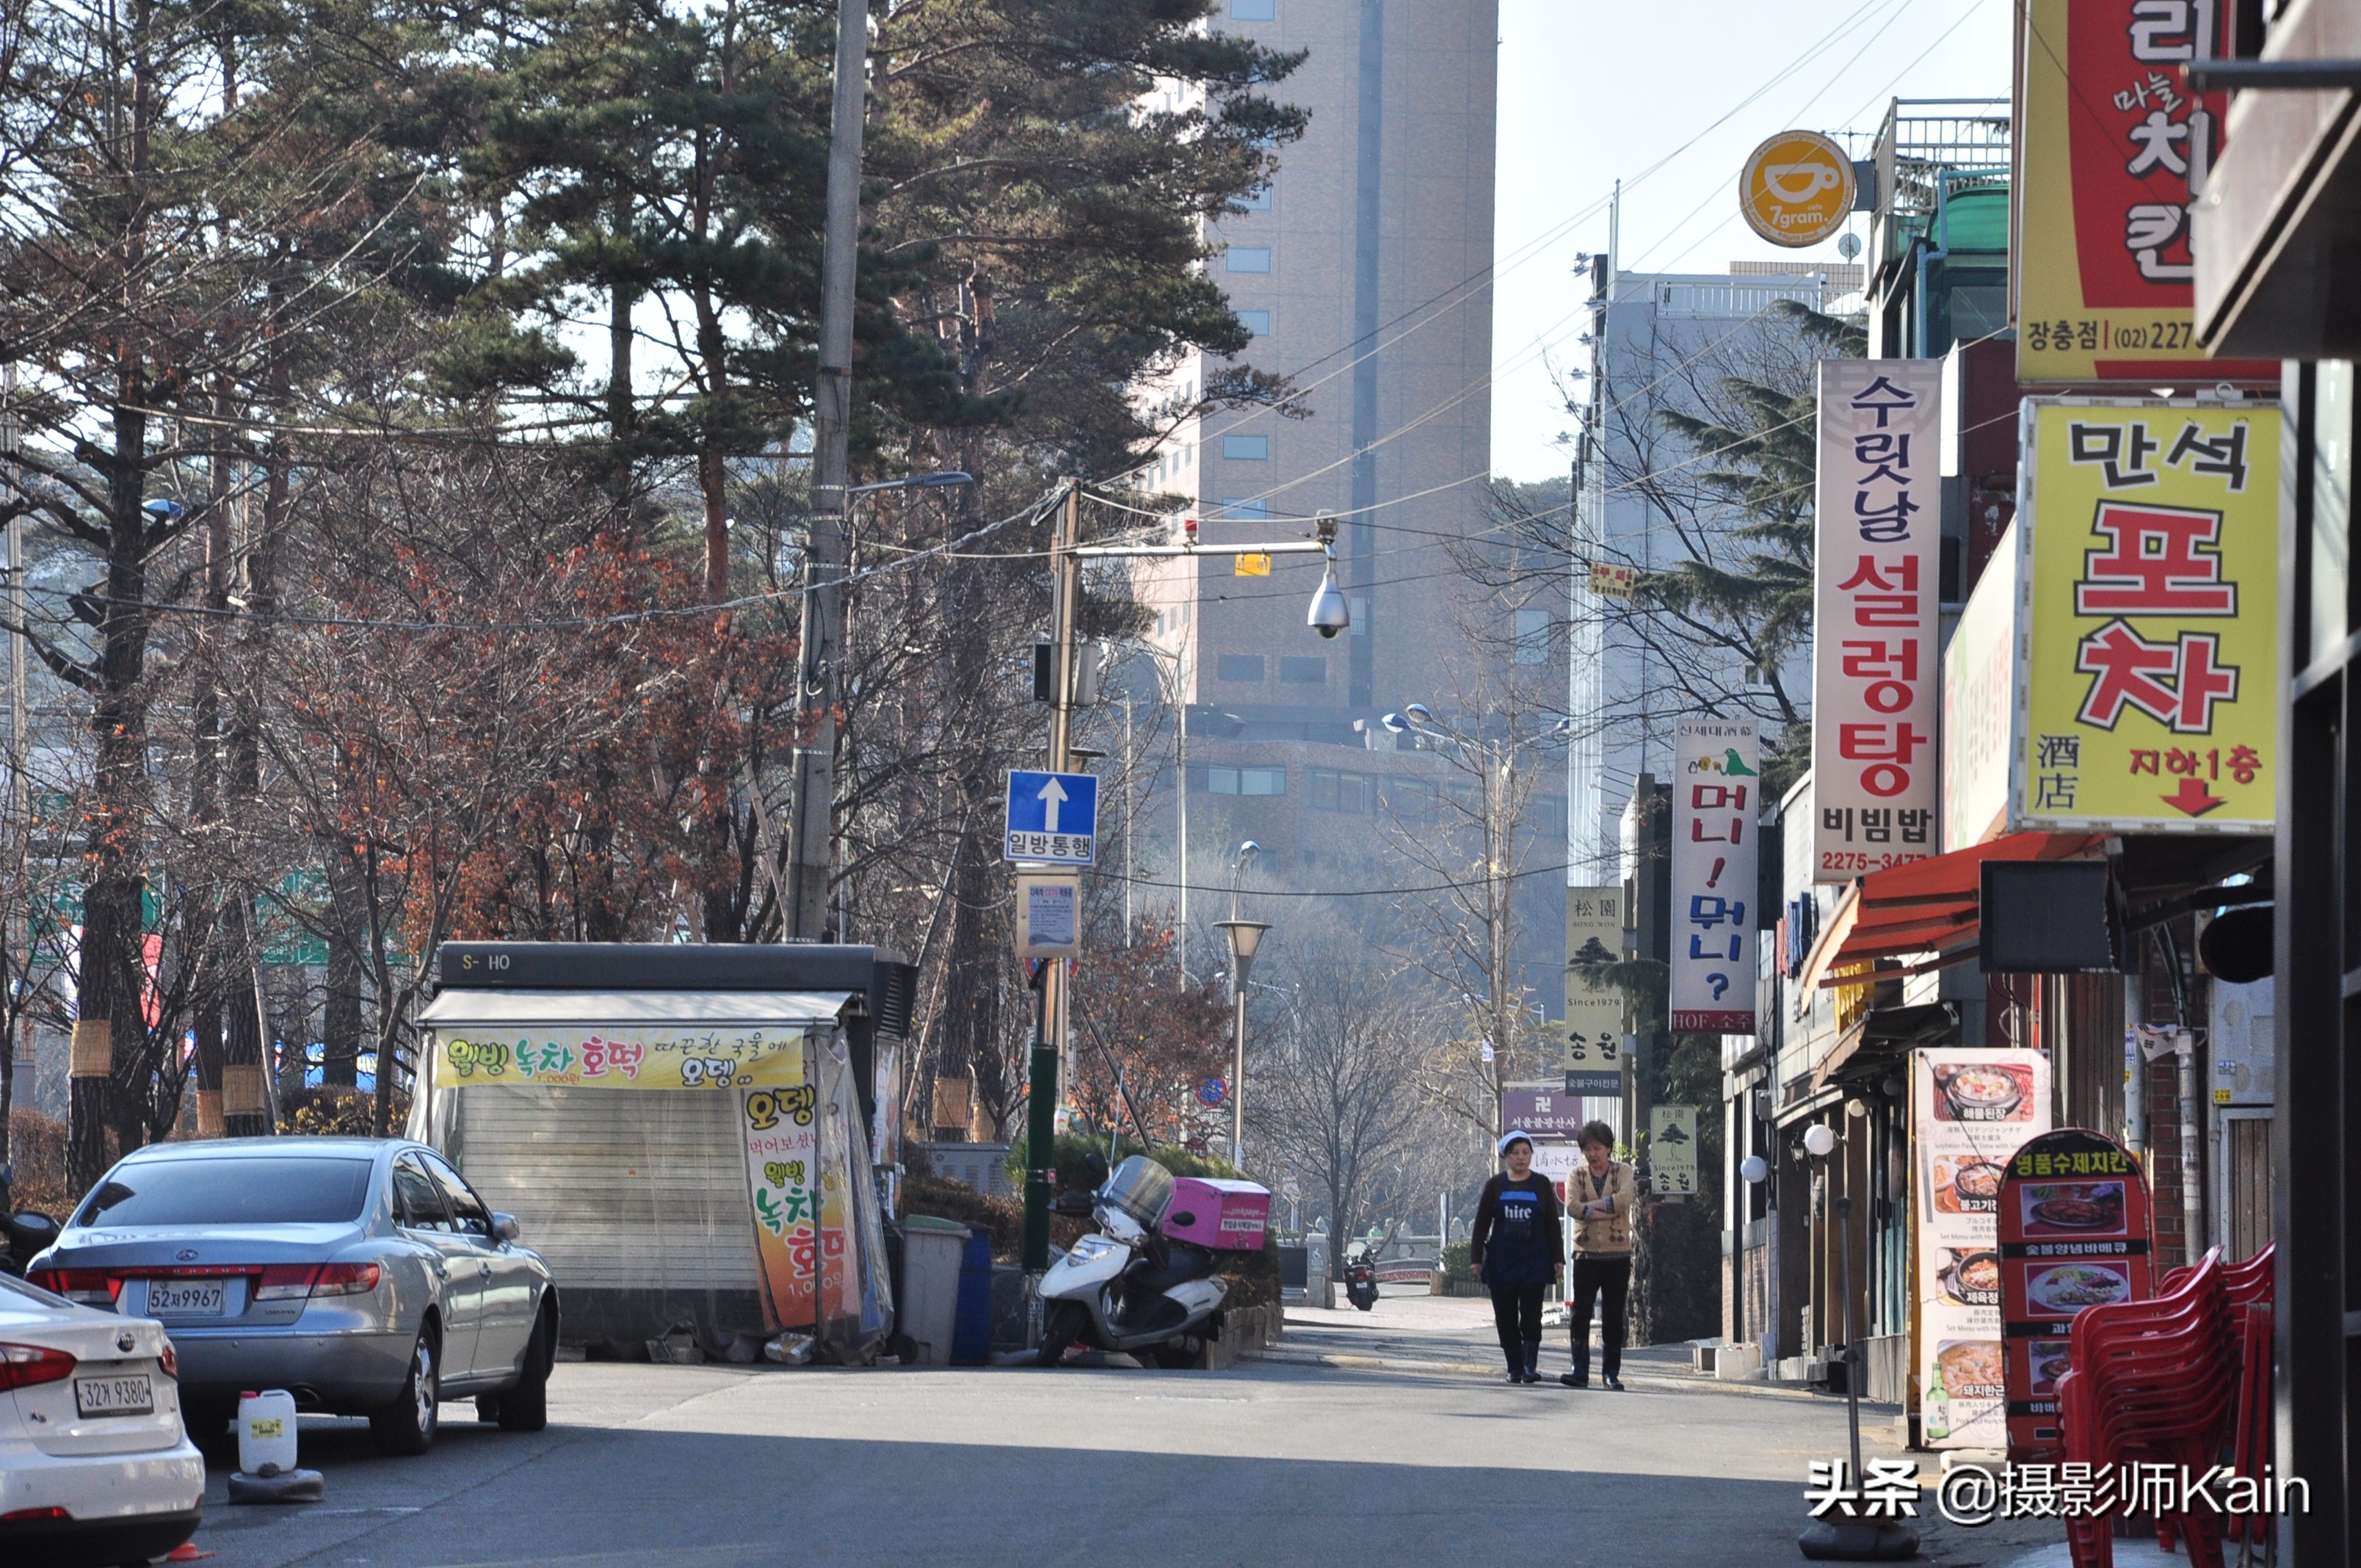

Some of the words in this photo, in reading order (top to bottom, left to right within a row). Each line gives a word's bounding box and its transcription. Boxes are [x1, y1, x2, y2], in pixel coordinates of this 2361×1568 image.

[2114, 72, 2183, 113] 마늘
[1769, 206, 1829, 229] 7gram.
[2028, 320, 2097, 351] 장충점
[2114, 327, 2147, 349] (02)
[1850, 375, 1921, 542] 수릿날
[2069, 421, 2248, 493] 만석
[2073, 498, 2241, 735] 포차
[1836, 555, 1927, 797] 설렁탕
[2036, 734, 2081, 810] 酒店
[1823, 807, 1933, 843] 비빔밥
[1009, 833, 1091, 858] 일방통행
[1575, 899, 1615, 918] 松園
[448, 1039, 509, 1077] 웰빙
[515, 1039, 575, 1078] 녹차
[581, 1036, 644, 1080] 호떡
[656, 1032, 721, 1054] 따끈한
[732, 1032, 788, 1061] 국물에
[1569, 1031, 1617, 1060] 송원
[747, 1084, 816, 1130] 오뎅
[1963, 1108, 2006, 1119] 해물된장
[764, 1160, 805, 1188] 웰빙
[756, 1187, 823, 1234] 녹차
[150, 1289, 222, 1308] 52저9967
